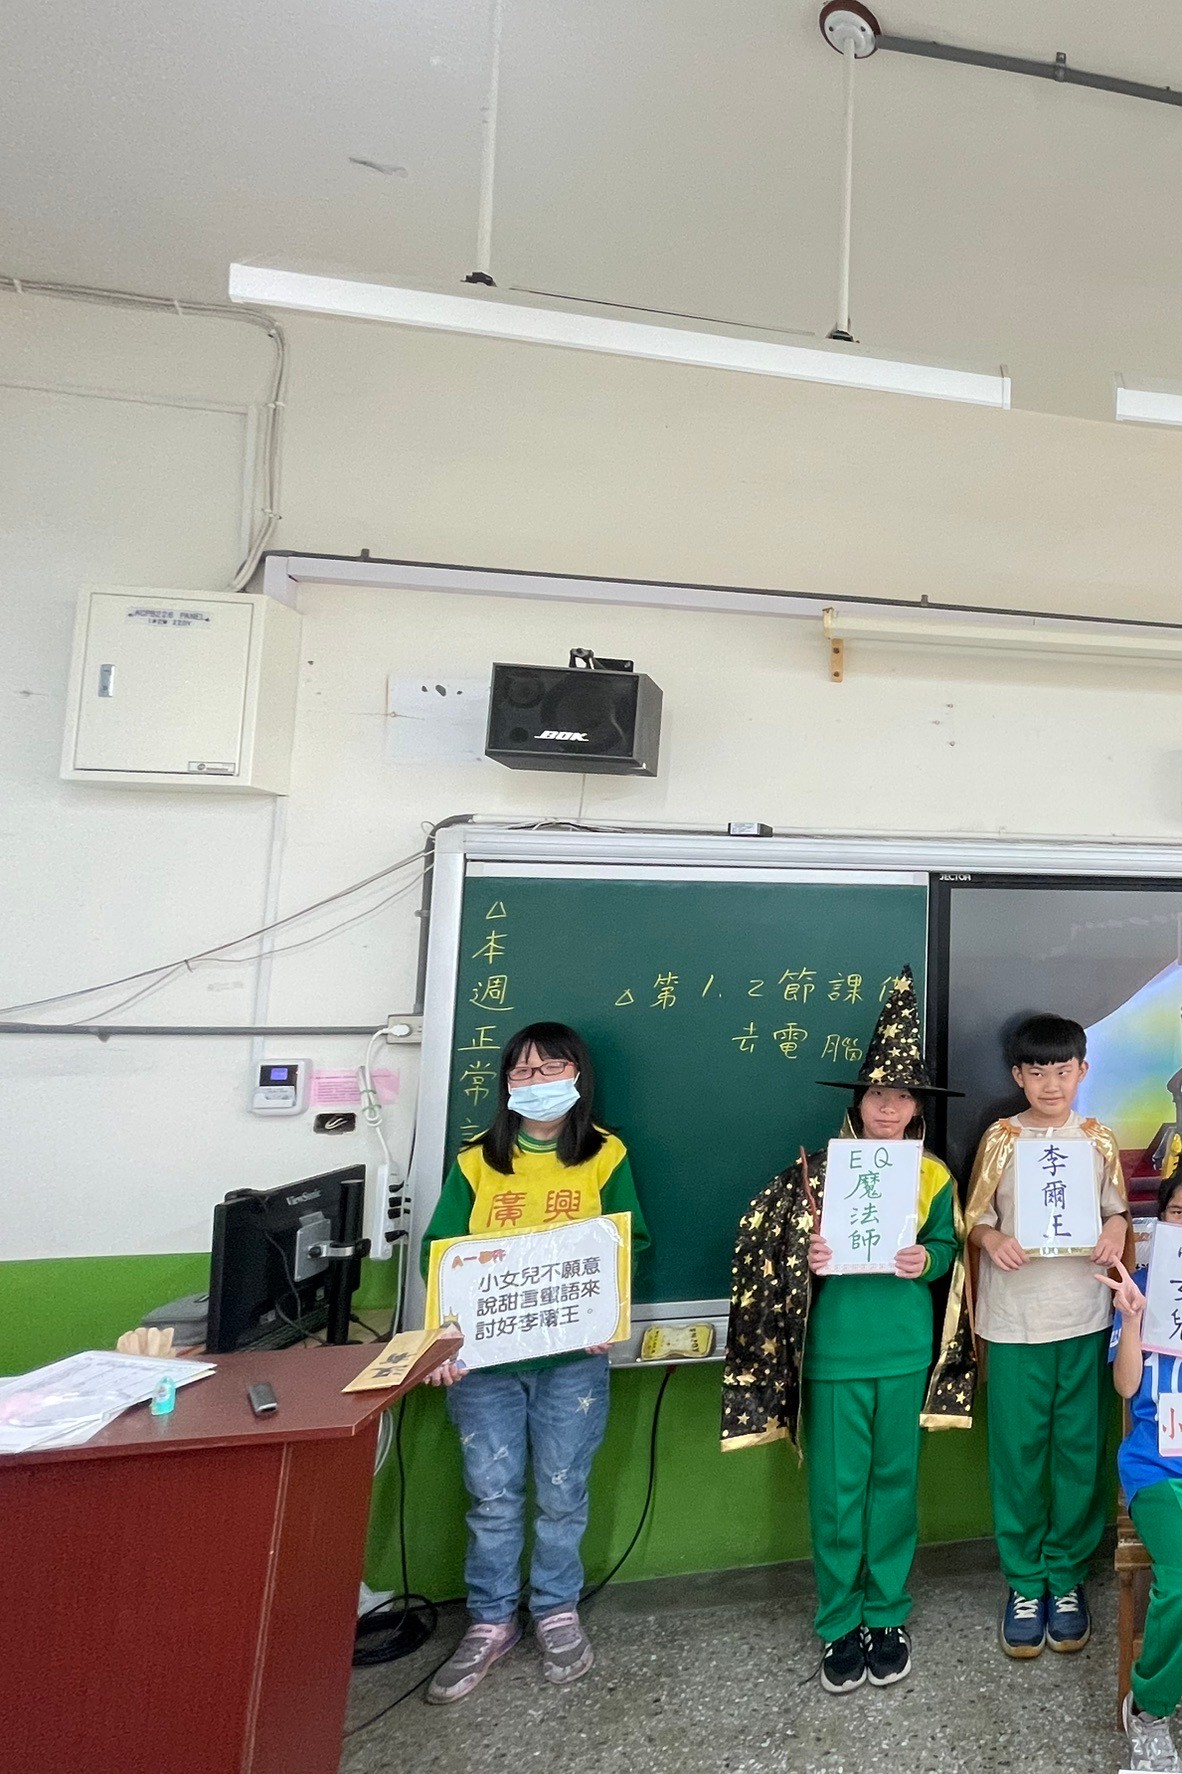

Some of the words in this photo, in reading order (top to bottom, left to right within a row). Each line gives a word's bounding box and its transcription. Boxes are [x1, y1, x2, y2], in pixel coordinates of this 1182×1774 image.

[458, 930, 514, 1142] 本週正常
[731, 1022, 863, 1062] 去電腦
[849, 1147, 893, 1169] EQ
[486, 1189, 582, 1228] 廣興
[1038, 1144, 1072, 1238] 李爾王
[844, 1170, 882, 1262] 魔法師
[479, 1256, 601, 1293] 小女兒不願意
[476, 1279, 601, 1317] 說甜言蜜語來
